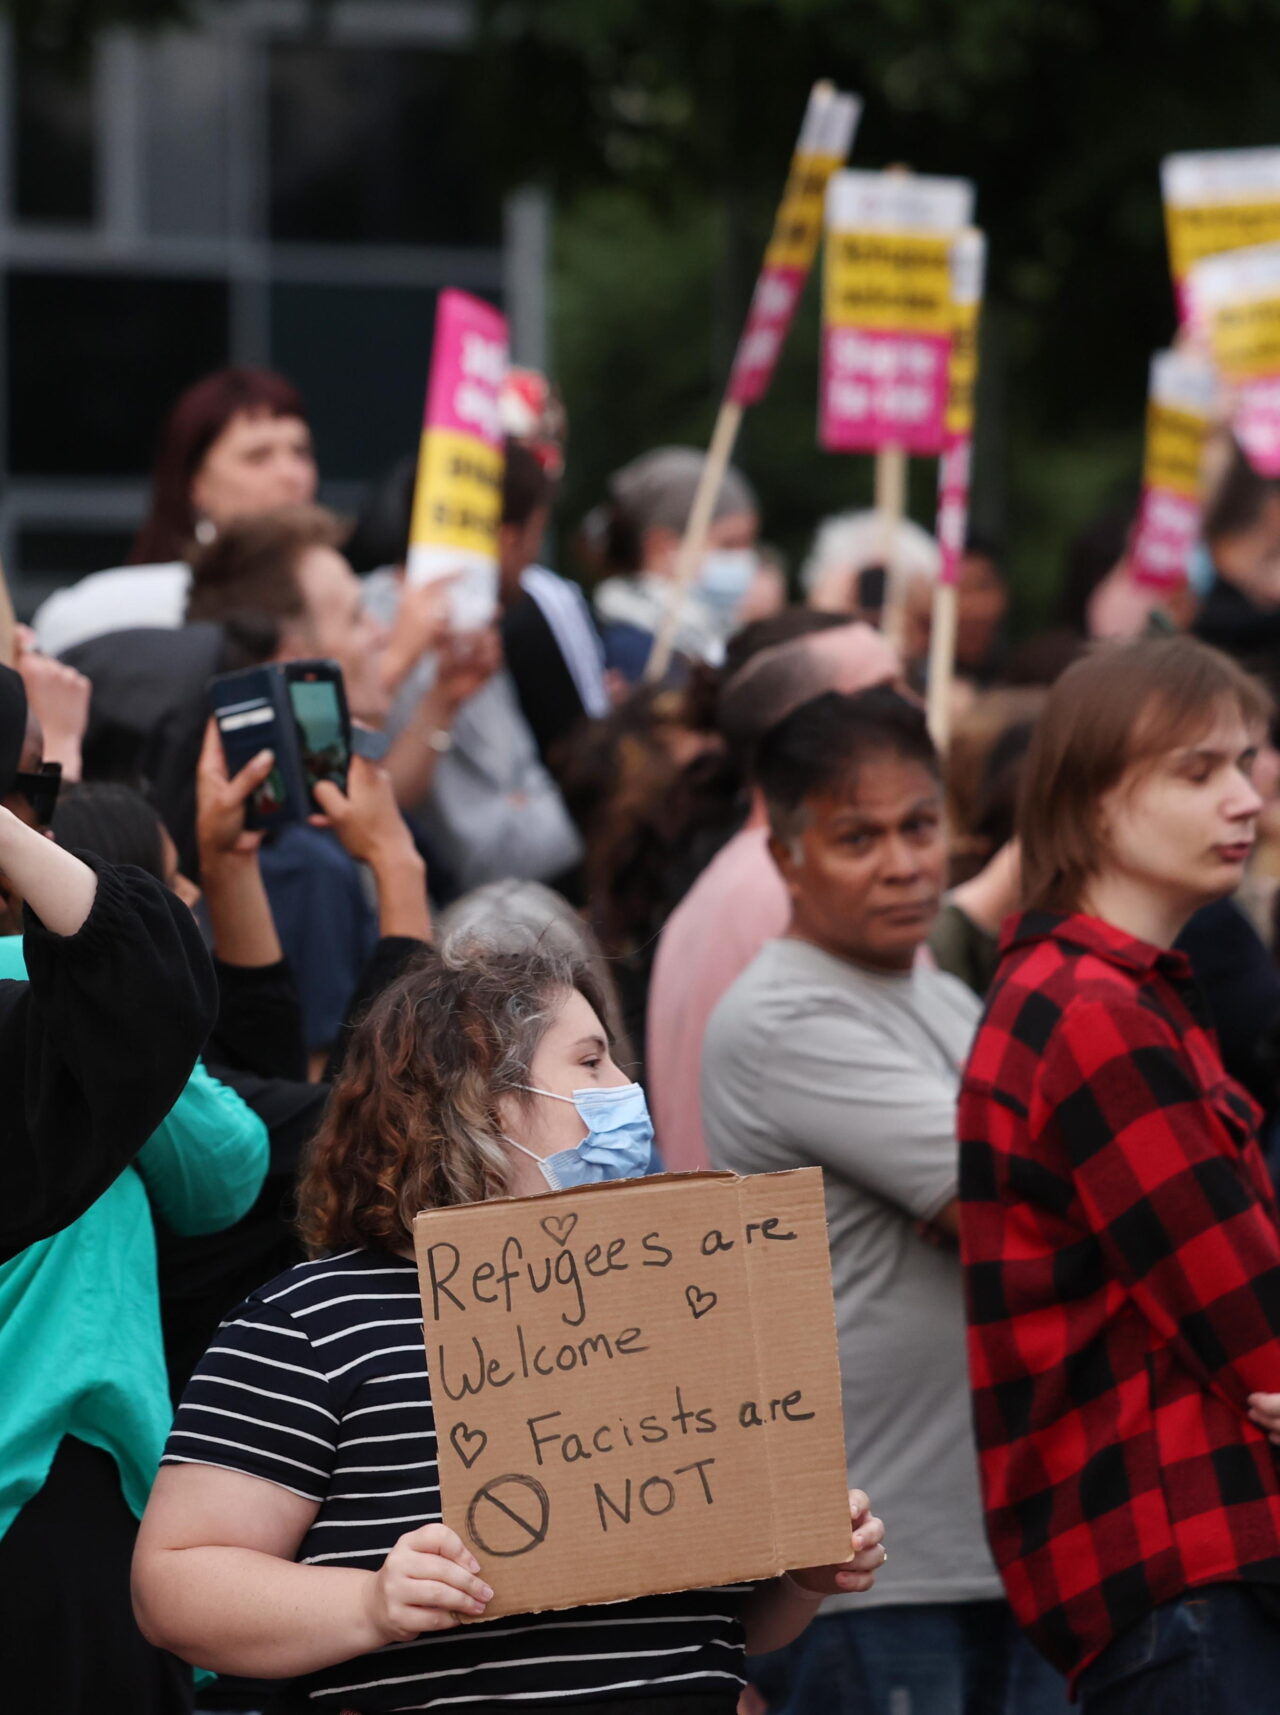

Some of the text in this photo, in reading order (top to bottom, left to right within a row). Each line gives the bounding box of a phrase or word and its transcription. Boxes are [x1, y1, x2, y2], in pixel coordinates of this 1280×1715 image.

[426, 1216, 798, 1327] Refugees are
[438, 1324, 650, 1401] Welcome
[526, 1385, 816, 1467] Facists are
[593, 1457, 717, 1532] NOT
